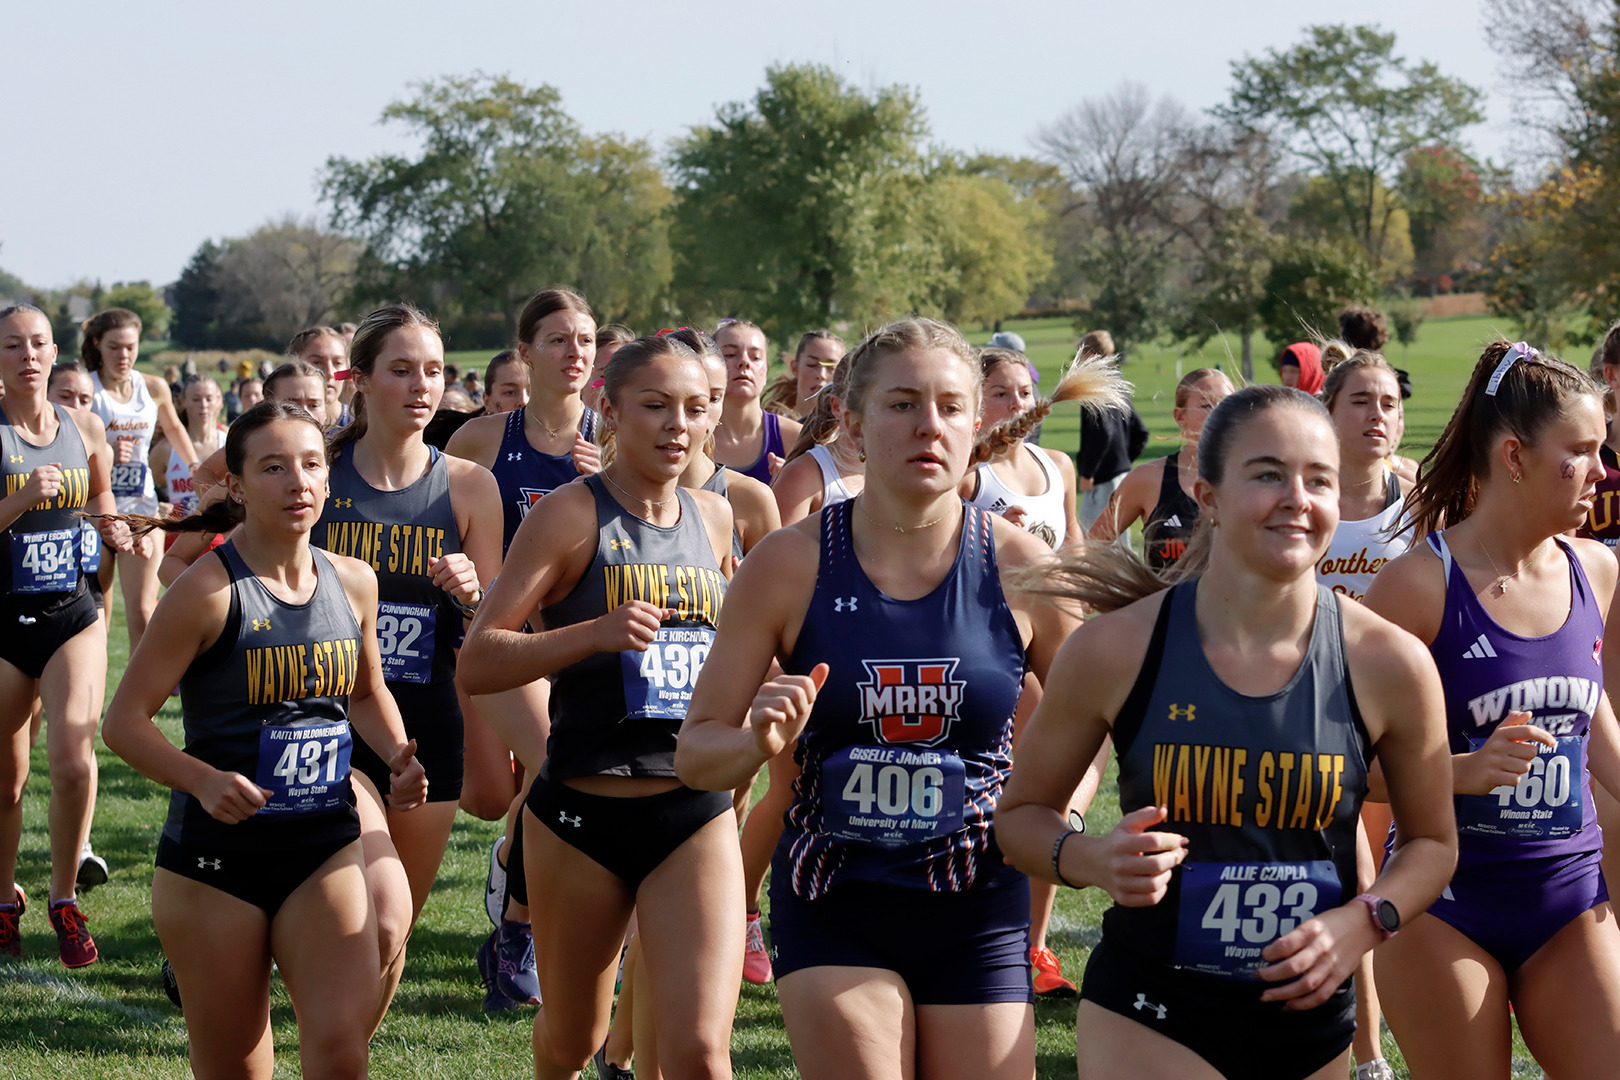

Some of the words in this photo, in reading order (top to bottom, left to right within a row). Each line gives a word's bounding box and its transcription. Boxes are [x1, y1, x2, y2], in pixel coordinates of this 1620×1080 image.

[22, 540, 75, 574] 434
[327, 521, 384, 572] WAYNE
[388, 524, 445, 577] STATE
[1315, 546, 1392, 577] orthe
[603, 563, 671, 621] WAYNE
[381, 604, 431, 618] CUNNINGHAM
[376, 615, 423, 657] 32
[245, 644, 308, 705] WAYNE
[313, 638, 358, 698] STATE
[387, 656, 406, 666] State
[640, 643, 711, 689] 436
[658, 689, 680, 701] Wayne
[680, 690, 693, 700] Stat
[864, 683, 960, 719] MARY
[1467, 675, 1599, 728] WINONA
[270, 729, 303, 740] KAITLYN
[1529, 712, 1578, 735] ATE
[273, 738, 339, 786] 431
[849, 747, 895, 764] GISELLE
[288, 787, 310, 798] Wayne
[310, 785, 328, 795] State
[842, 762, 945, 818] 406
[1153, 743, 1247, 828] WAYNE
[1255, 750, 1345, 832] STATE
[849, 815, 898, 830] University
[900, 818, 910, 828] of
[911, 819, 938, 831] Mary
[1500, 809, 1531, 819] Winona
[1532, 809, 1553, 819] State
[1220, 865, 1259, 881] ALLIE
[1259, 865, 1308, 881] CZAPLA
[1201, 882, 1318, 943] 433
[1224, 945, 1261, 959] Wayne
